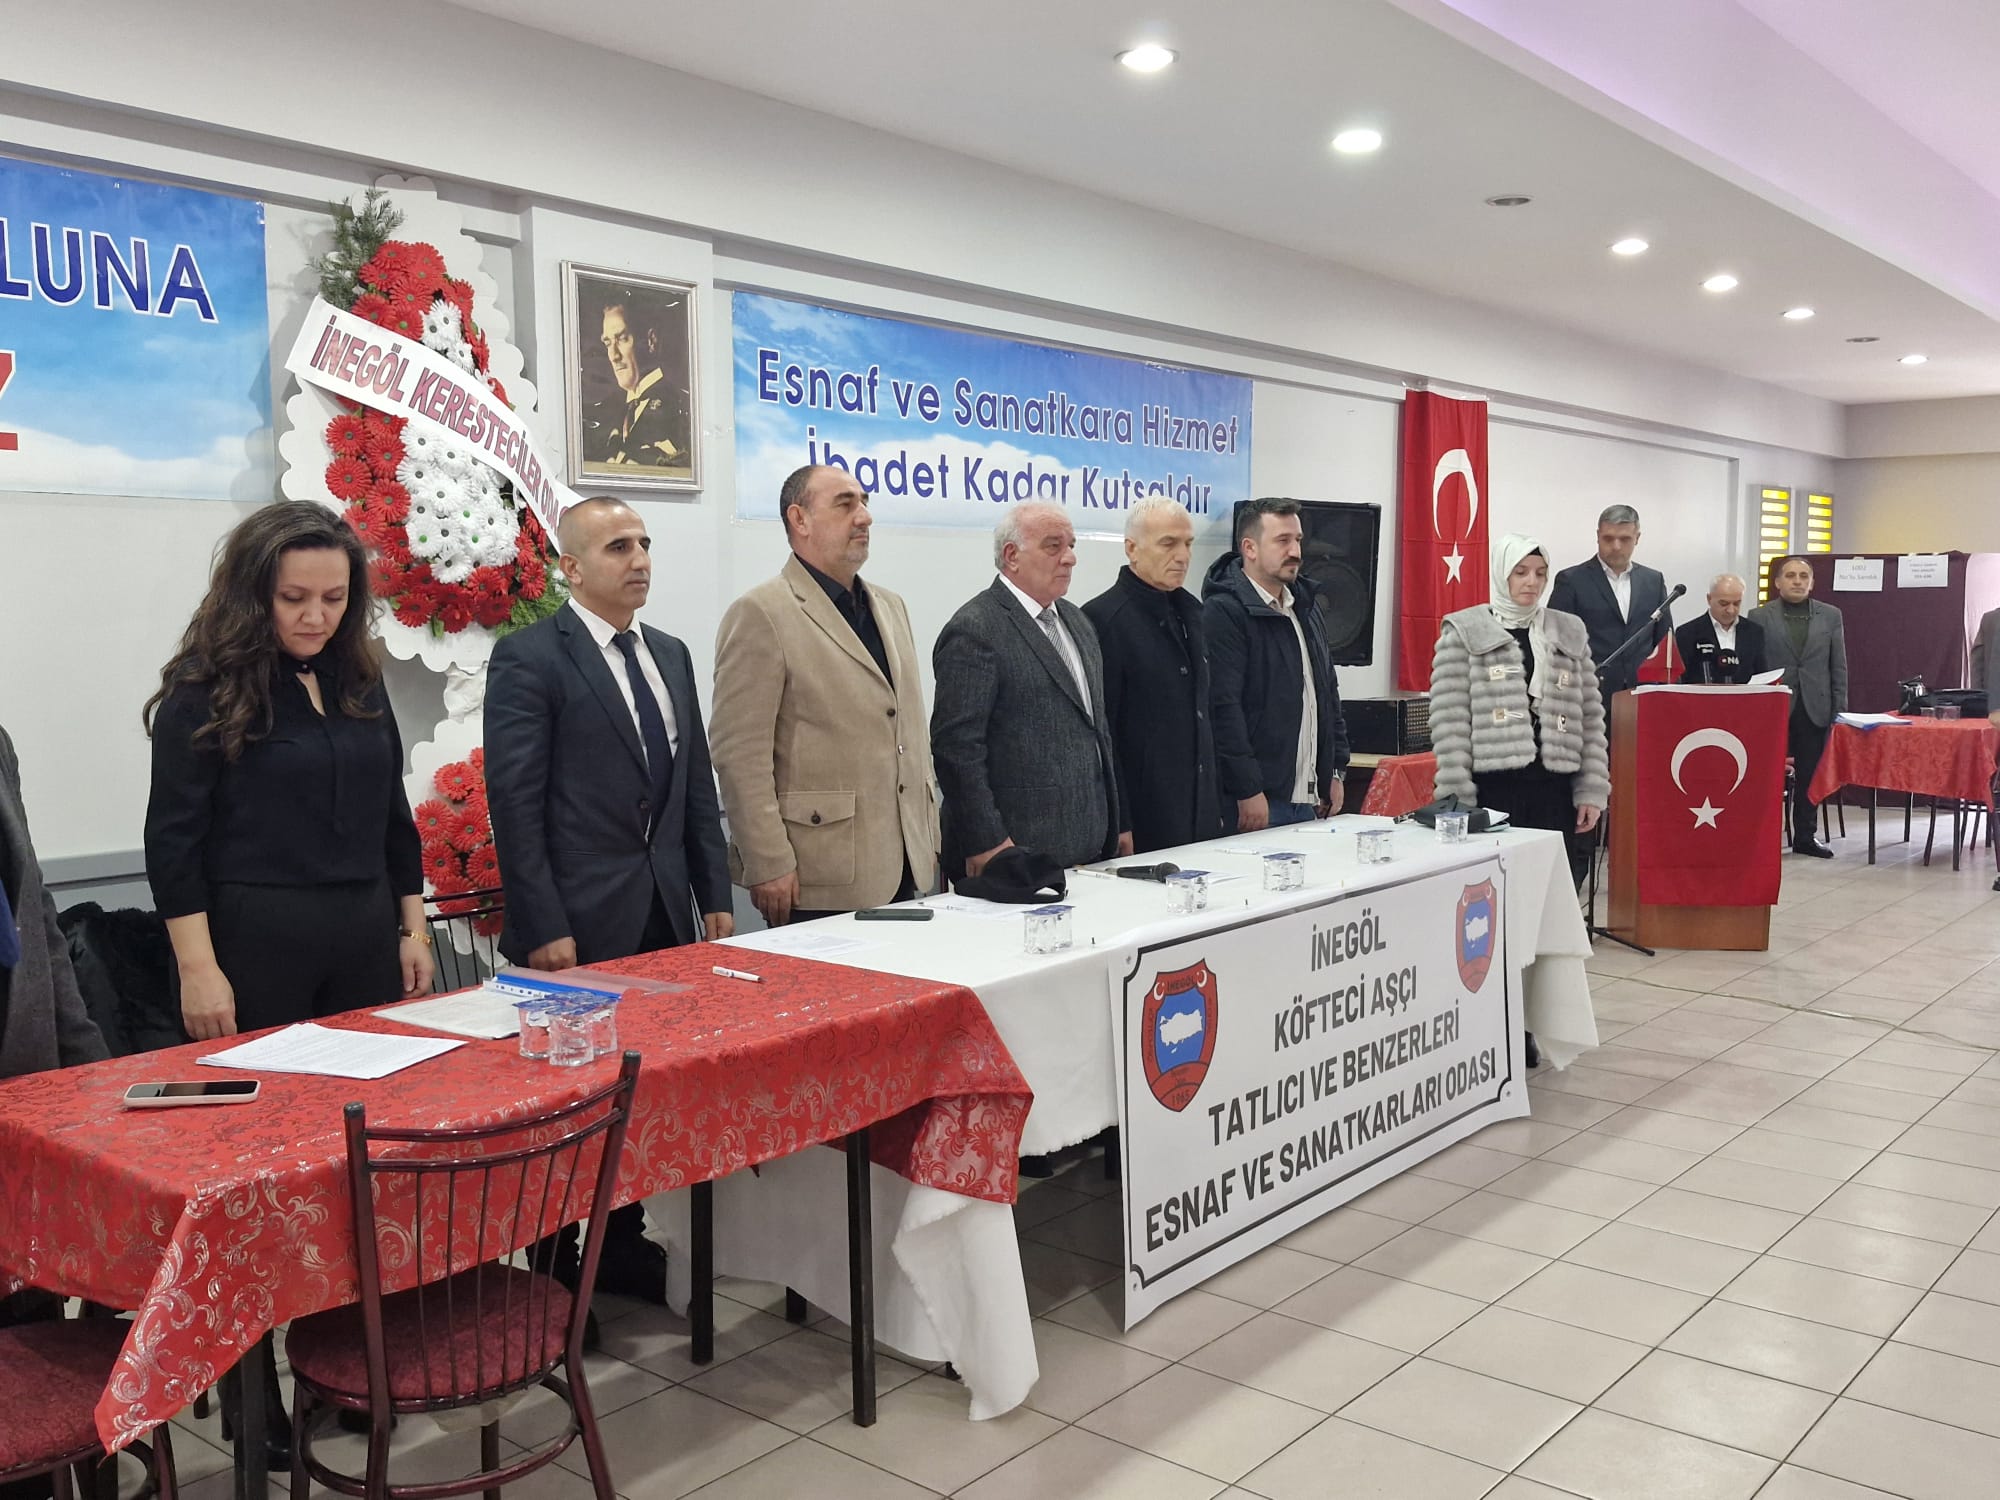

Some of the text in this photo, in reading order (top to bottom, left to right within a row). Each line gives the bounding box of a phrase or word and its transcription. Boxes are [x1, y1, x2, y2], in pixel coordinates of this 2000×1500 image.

[310, 315, 569, 534] İNEGÖL KERESTECİLER ODA
[758, 348, 1238, 454] Esnaf ve Sanatkara Hizmet
[964, 457, 1070, 504] Kadar
[1311, 907, 1387, 972] İNEGÖL
[1274, 973, 1365, 1052] KÖFTECİ
[1370, 965, 1417, 1017] AŞÇI
[1208, 998, 1460, 1146] TATLICI VE BENZERLERİ
[1146, 1047, 1496, 1252] ESNAF VE SANATKARLARI ODASI
